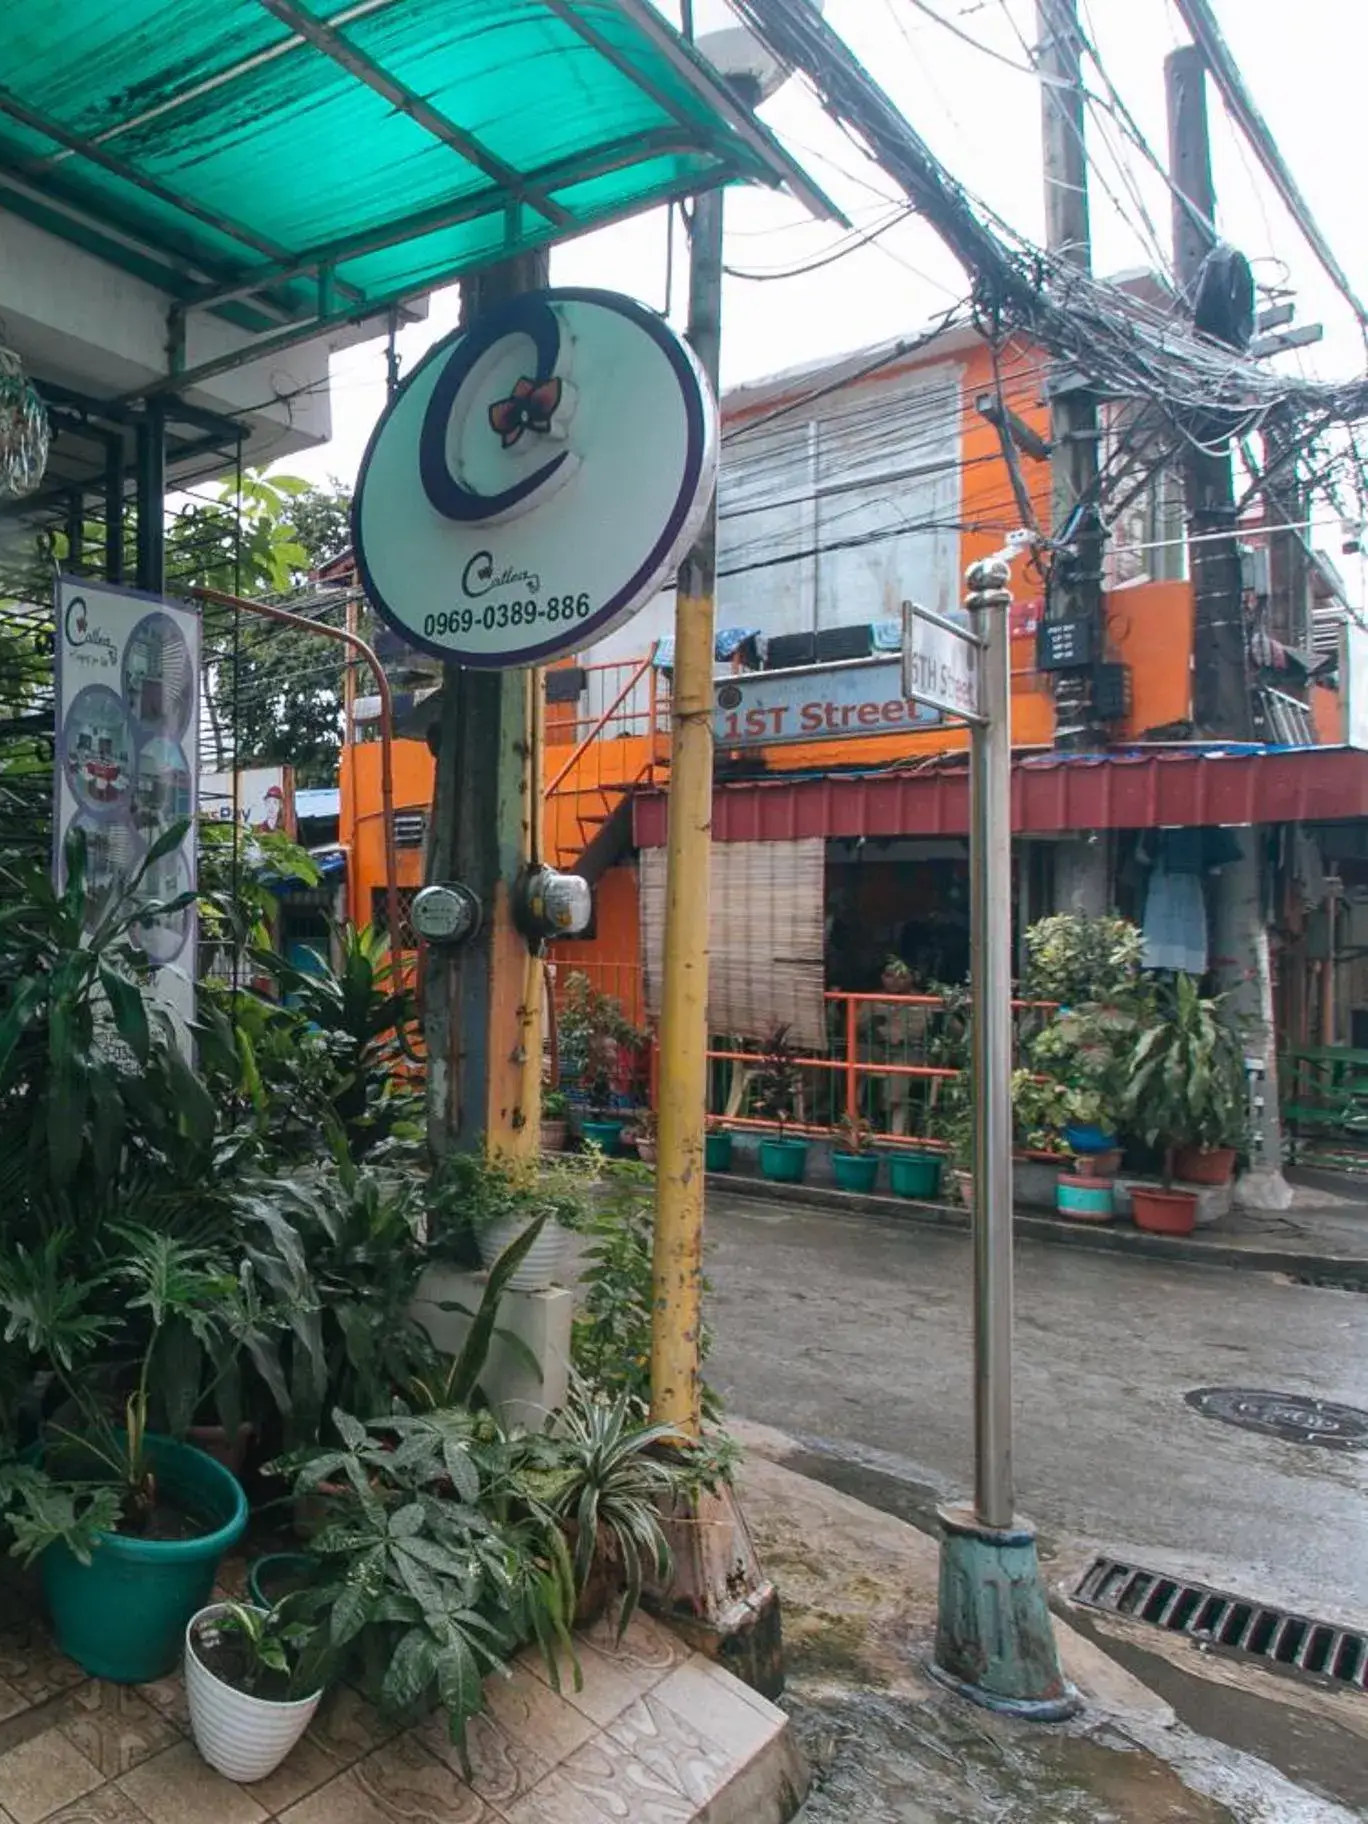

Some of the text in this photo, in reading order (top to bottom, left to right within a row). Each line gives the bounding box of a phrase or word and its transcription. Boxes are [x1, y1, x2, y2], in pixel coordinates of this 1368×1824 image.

[423, 592, 590, 636] 0969-0389-886
[723, 698, 922, 740] 1ST Street
